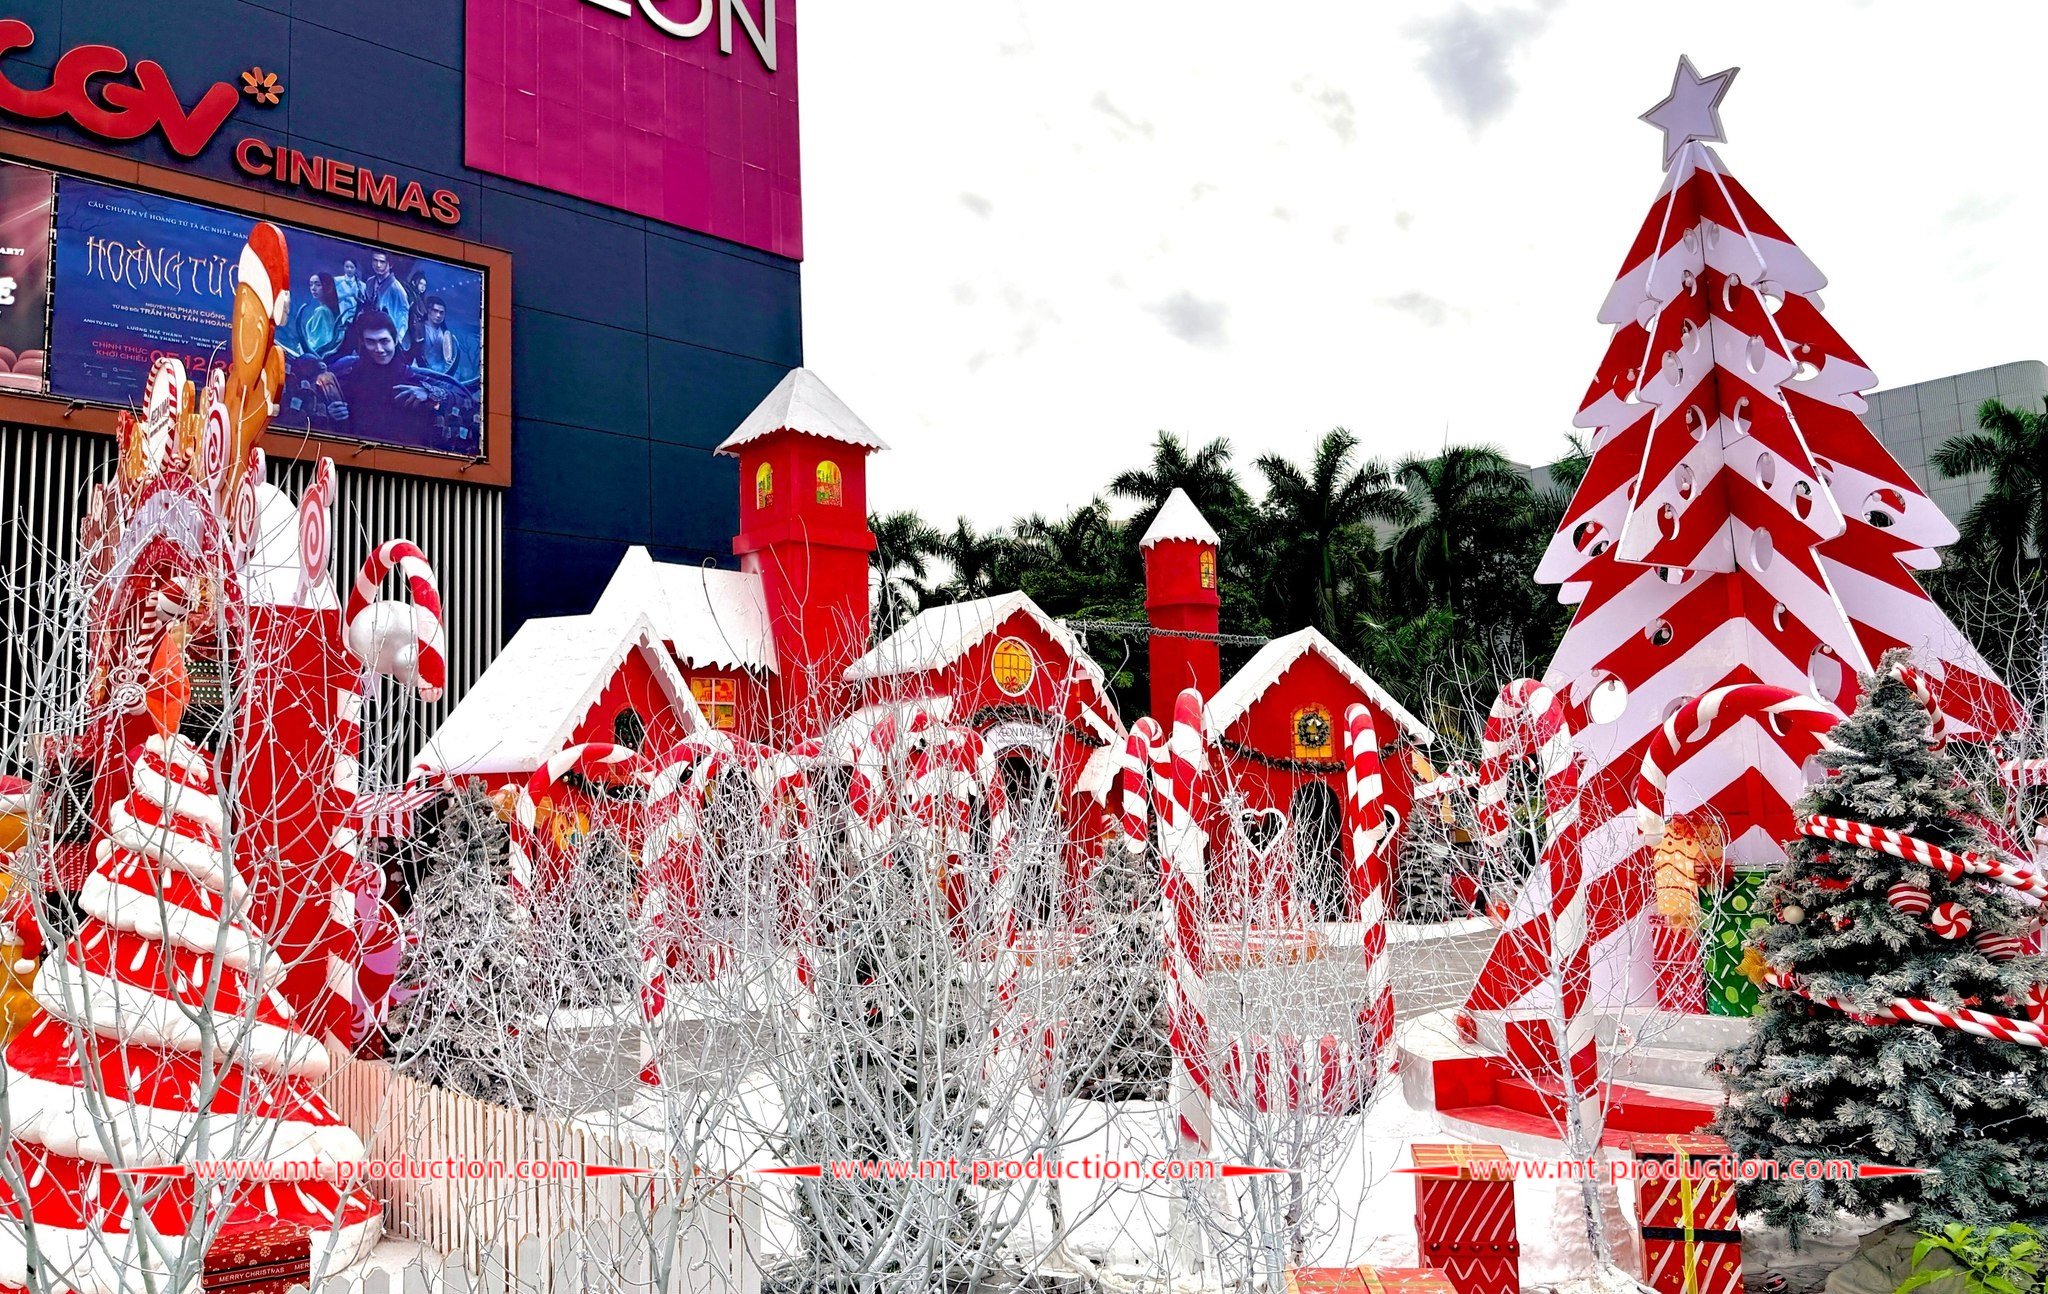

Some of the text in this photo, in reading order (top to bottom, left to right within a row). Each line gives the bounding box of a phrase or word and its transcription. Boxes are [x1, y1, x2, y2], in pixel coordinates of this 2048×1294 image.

[0, 20, 239, 157] CGV
[235, 137, 461, 225] CINEMAS
[87, 236, 185, 296] HOÀNG
[219, 1273, 245, 1283] MERRY
[245, 1267, 285, 1279] CHRISTMAS
